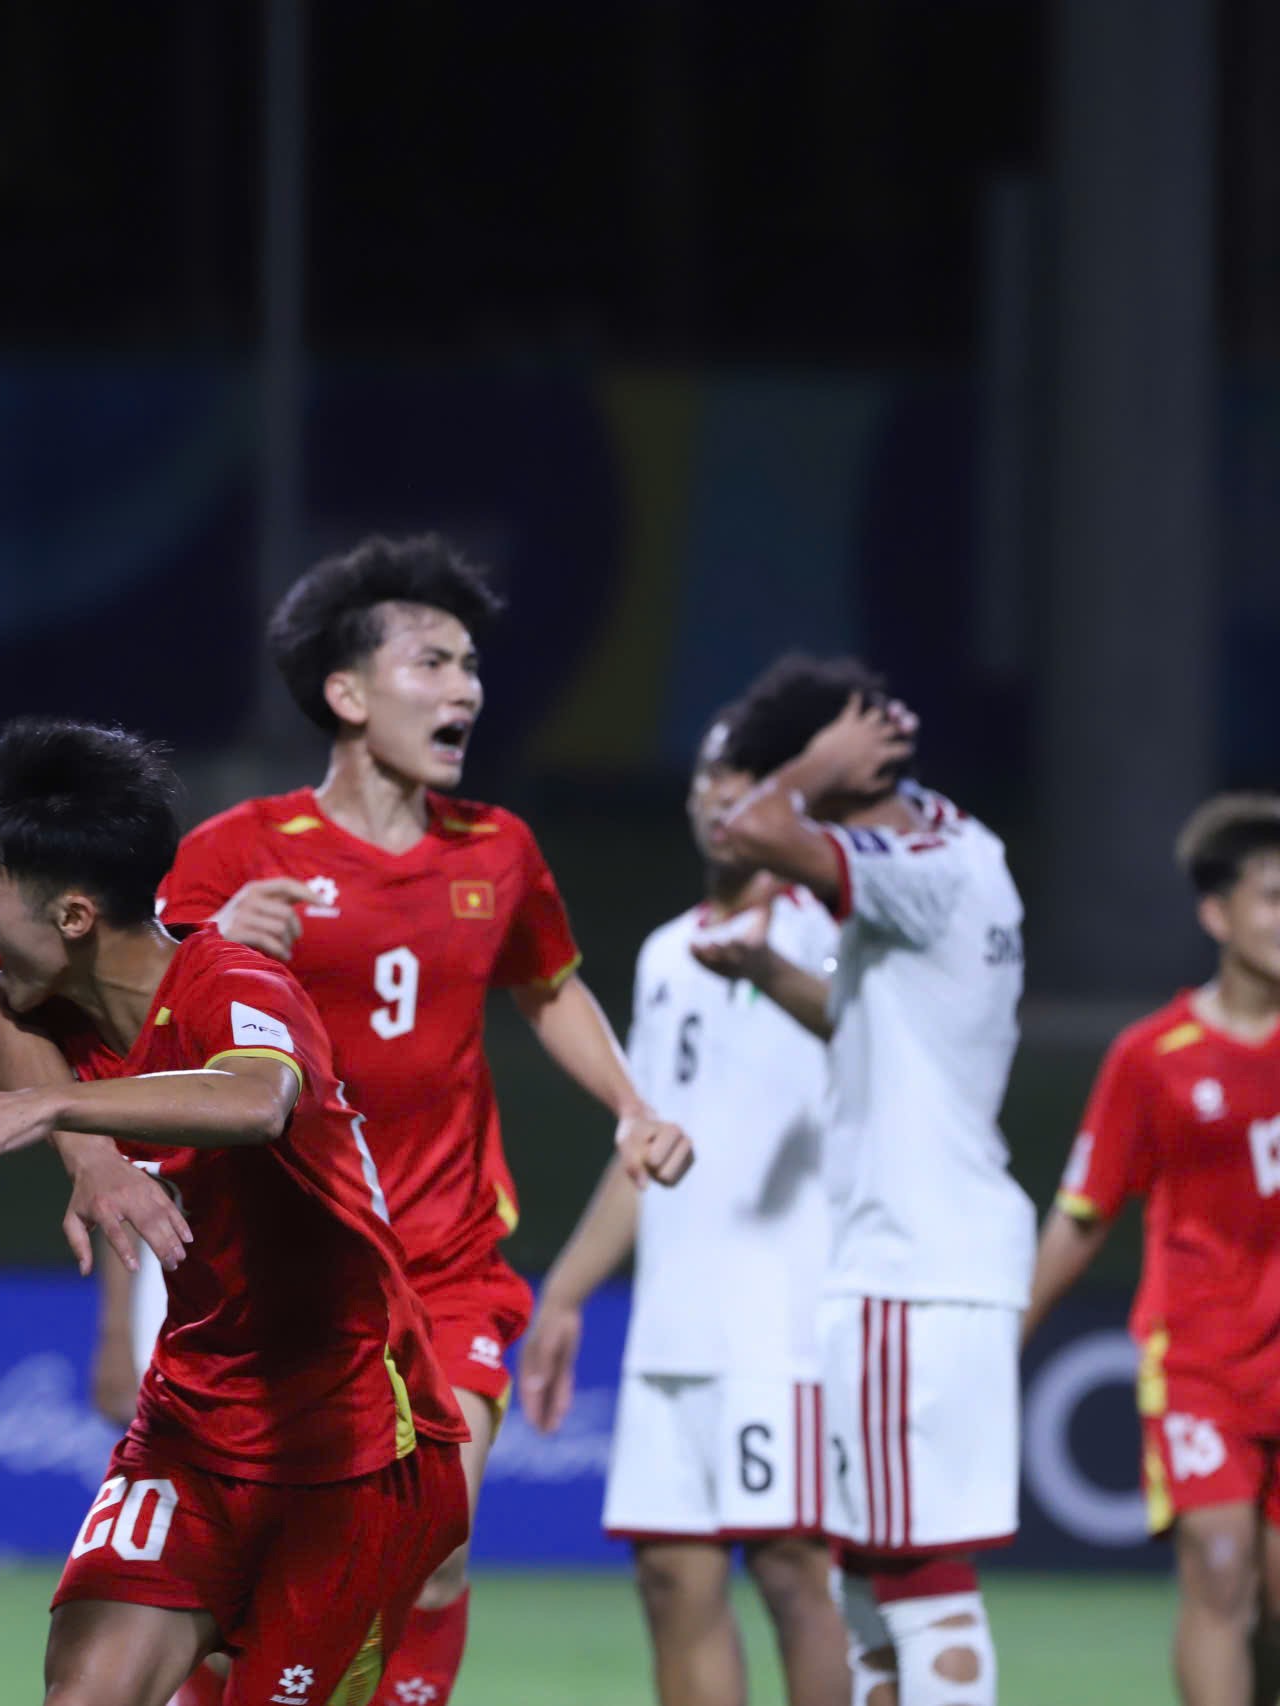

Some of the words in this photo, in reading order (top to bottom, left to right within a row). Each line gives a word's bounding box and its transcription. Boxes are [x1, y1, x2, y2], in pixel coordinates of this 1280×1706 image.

[371, 946, 419, 1040] 9
[739, 1425, 774, 1493] 6
[72, 1476, 179, 1561] 20
